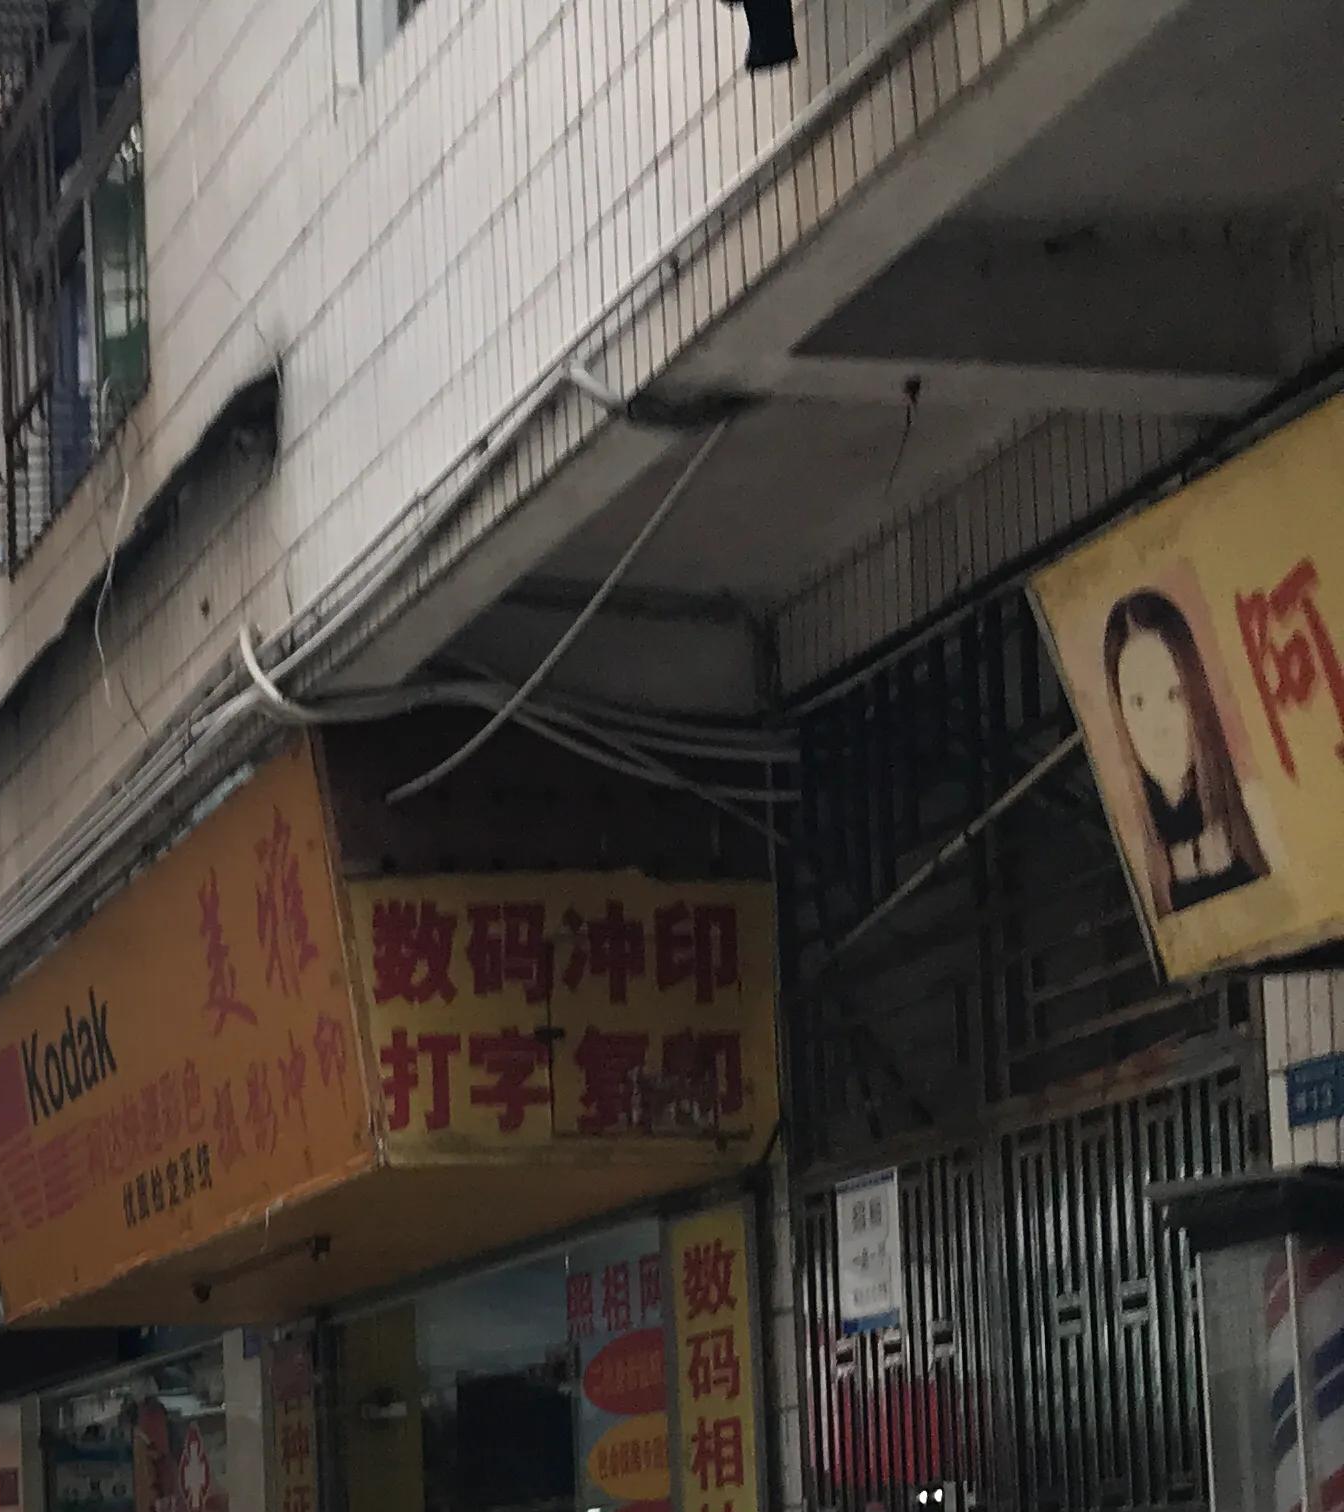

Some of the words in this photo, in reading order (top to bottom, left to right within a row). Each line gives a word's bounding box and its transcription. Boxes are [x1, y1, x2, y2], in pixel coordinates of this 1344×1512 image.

[1234, 555, 1344, 784] 阿
[373, 899, 739, 1006] 数码冲印
[21, 984, 117, 1125] Kodak
